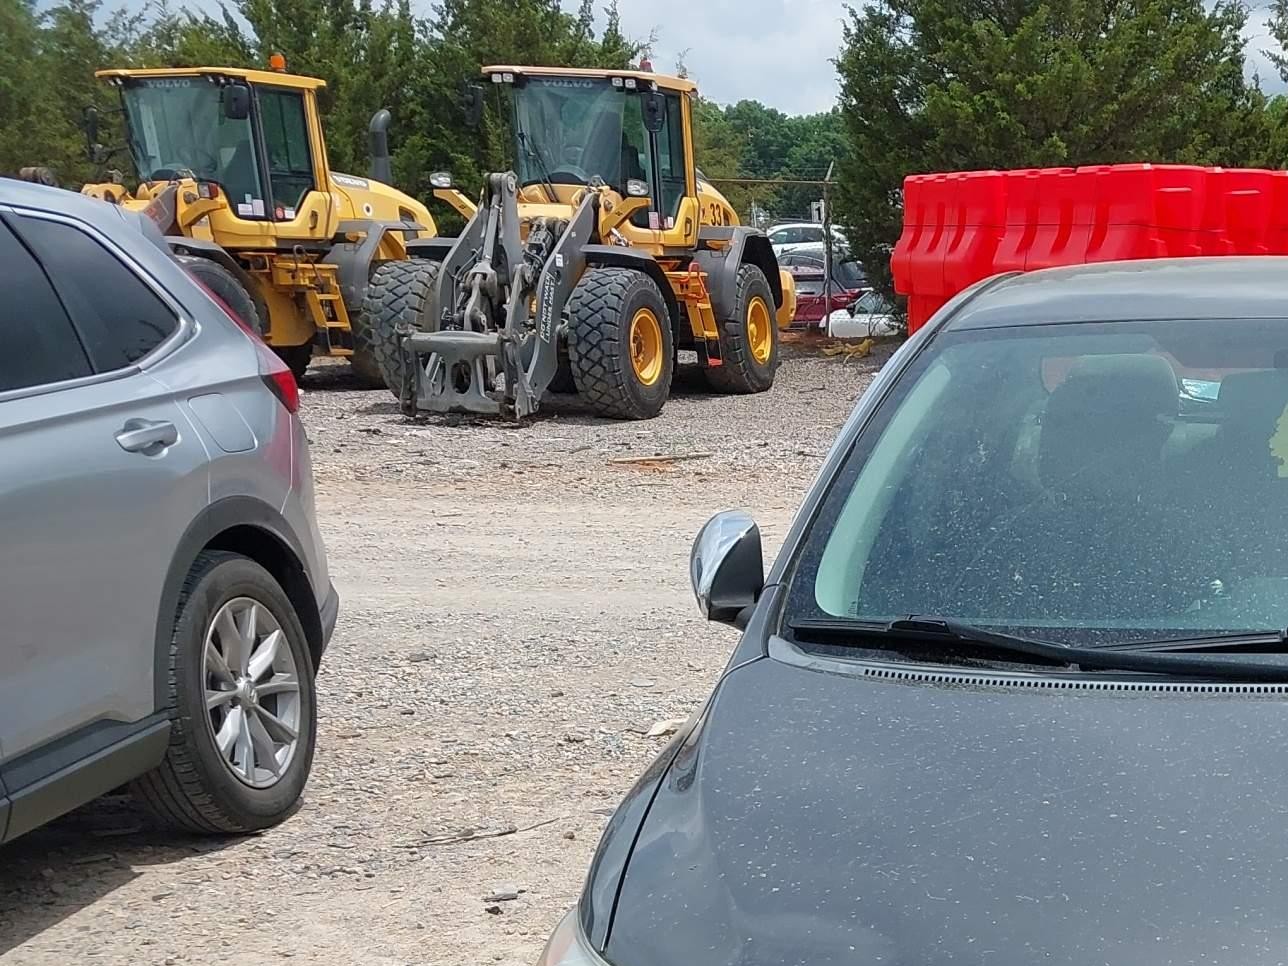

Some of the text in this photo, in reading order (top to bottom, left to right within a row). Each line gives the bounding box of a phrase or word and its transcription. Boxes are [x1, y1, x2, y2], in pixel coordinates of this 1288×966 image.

[147, 79, 191, 88] VOLVO
[543, 79, 593, 89] VOLVO
[709, 202, 722, 227] 33
